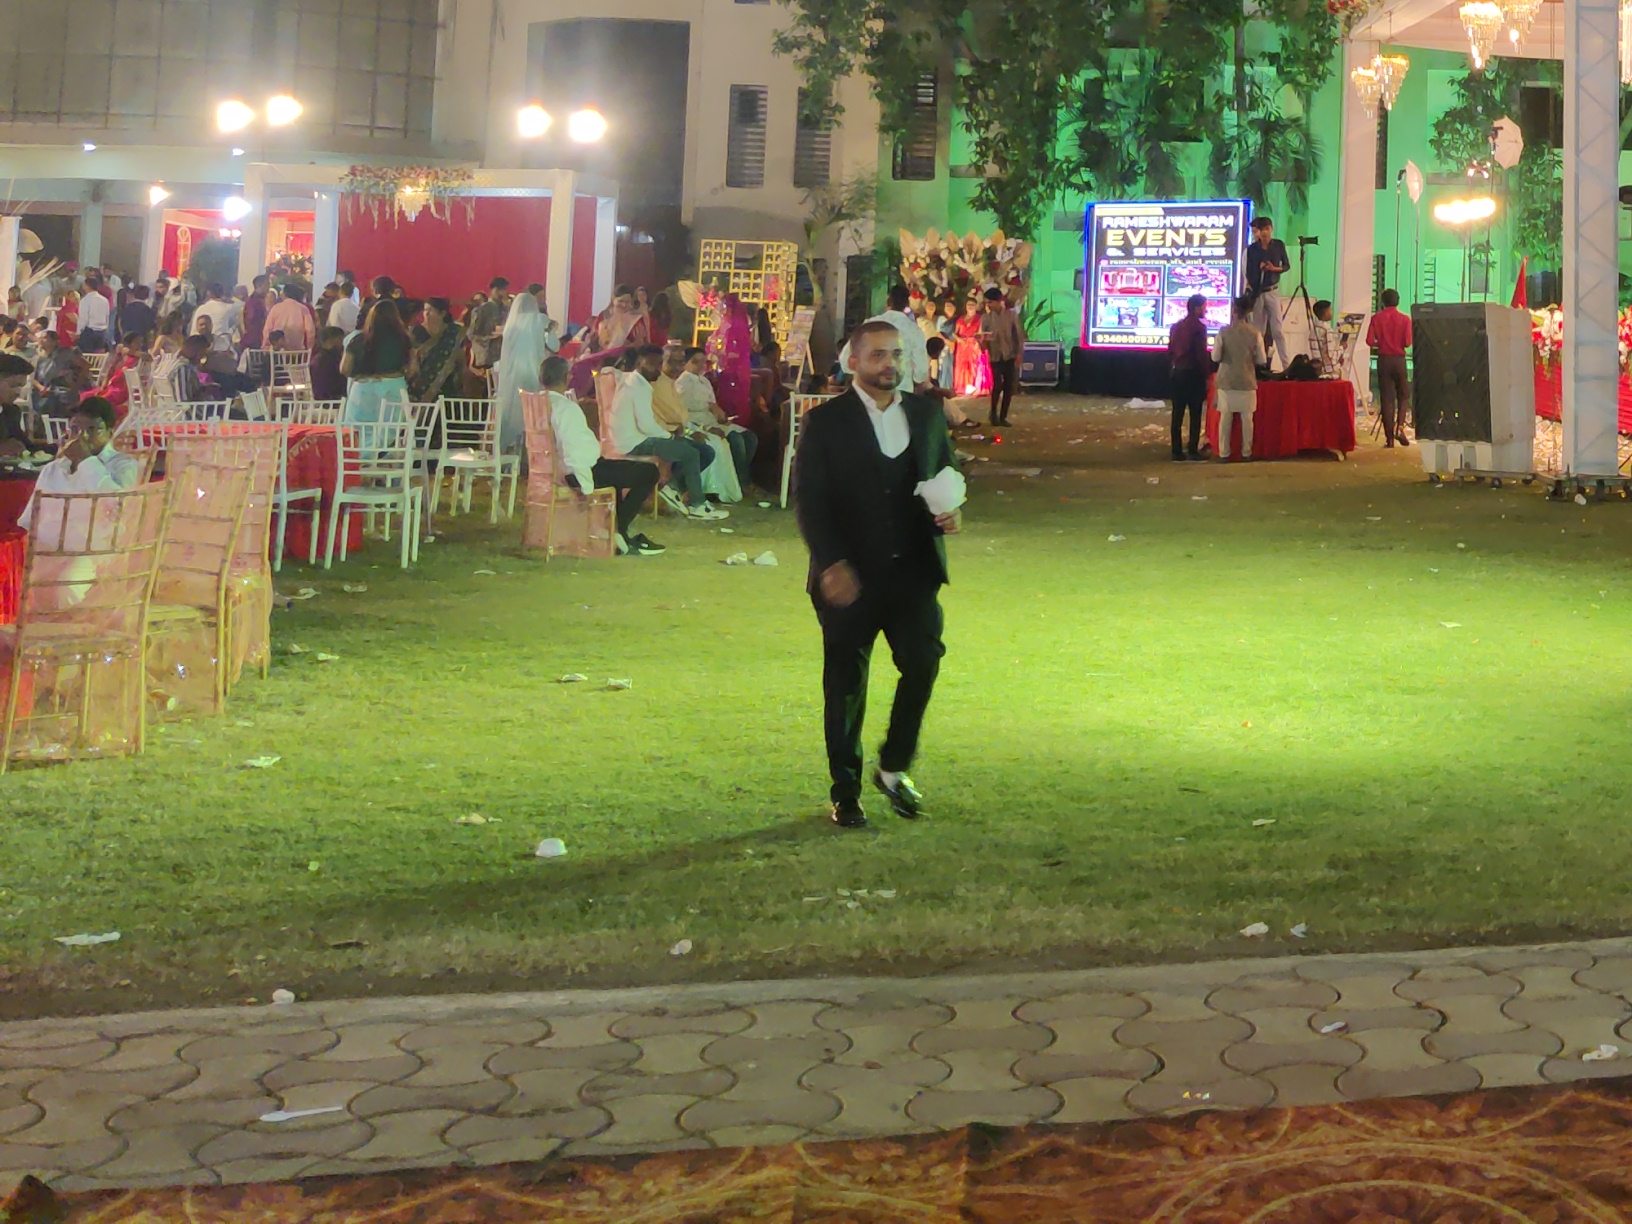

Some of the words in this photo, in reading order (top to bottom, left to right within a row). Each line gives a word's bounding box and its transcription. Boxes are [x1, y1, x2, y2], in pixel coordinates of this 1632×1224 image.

[1103, 215, 1234, 228] RAMESHWARAM
[1106, 229, 1227, 247] EVENTS
[1133, 247, 1227, 257] SERVICES
